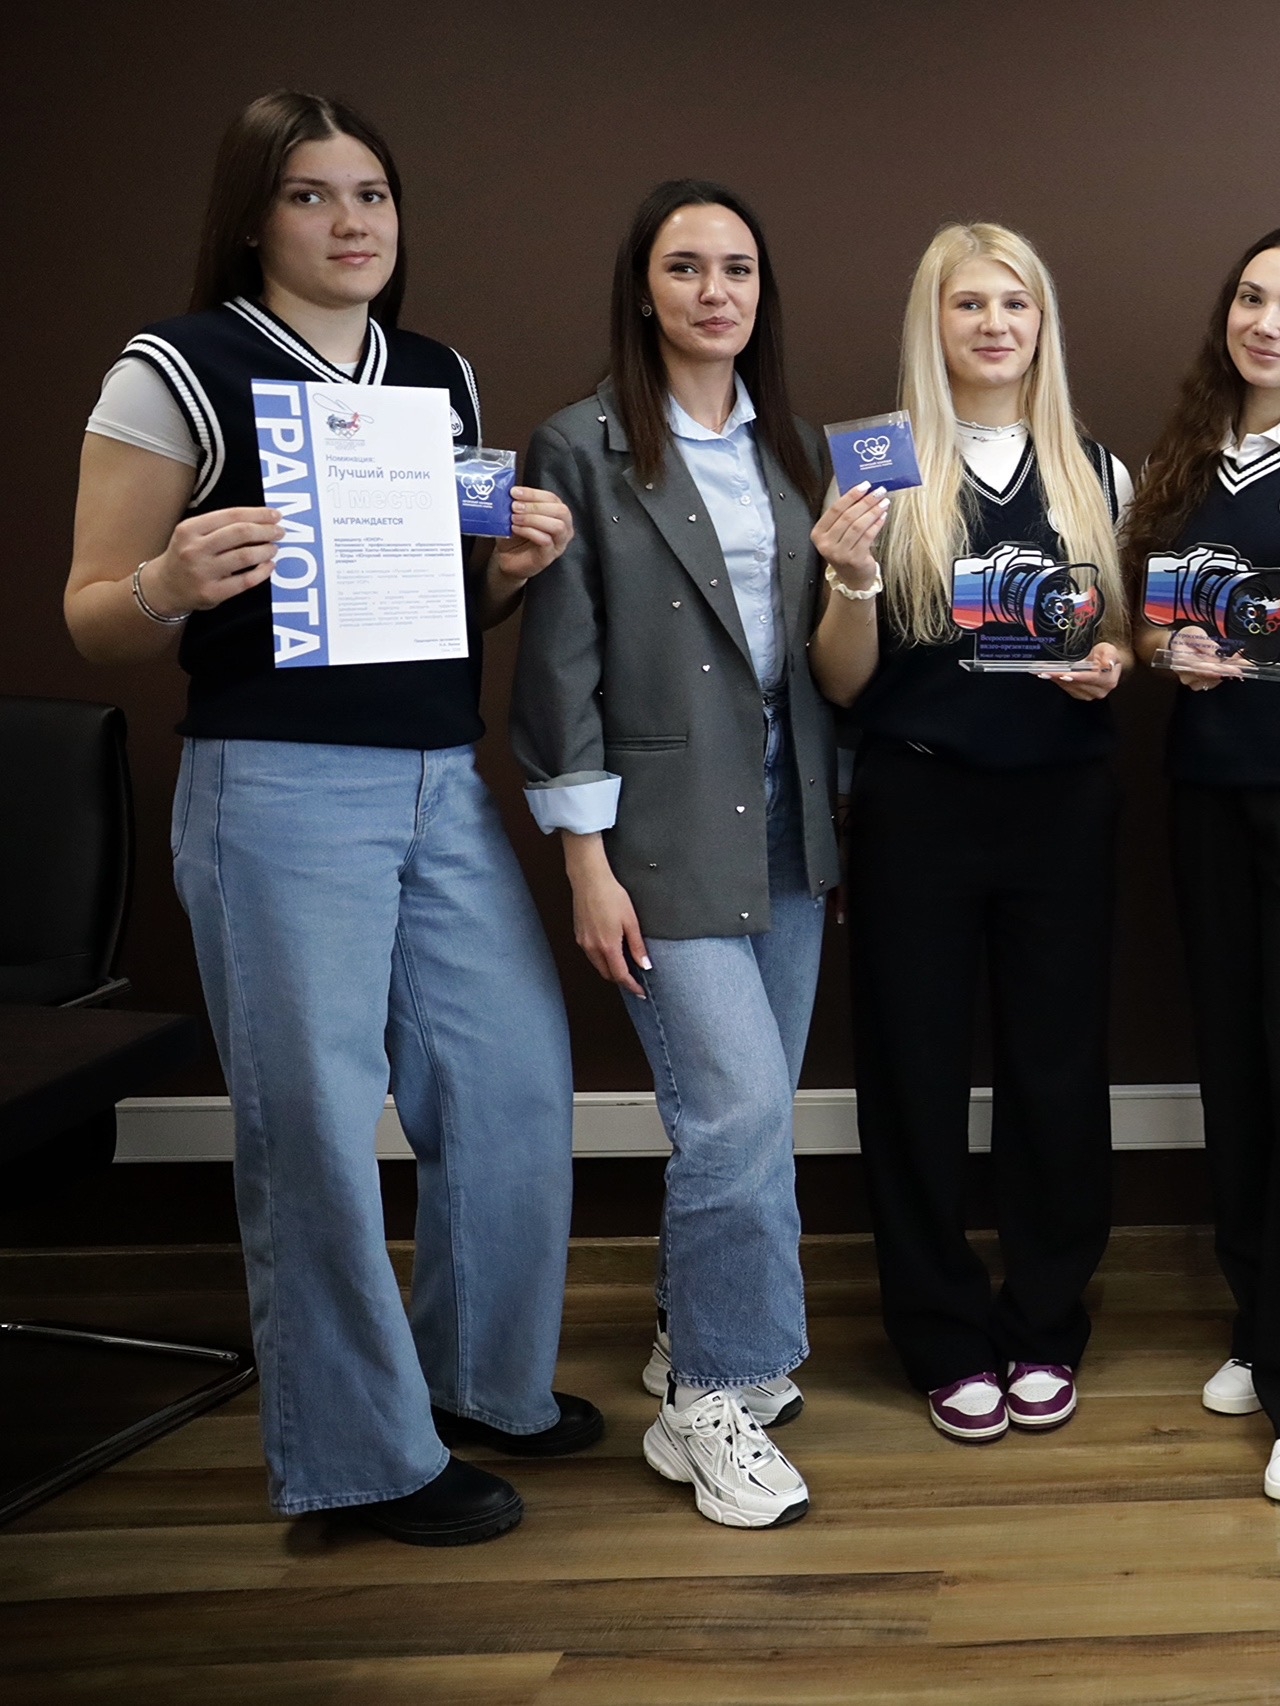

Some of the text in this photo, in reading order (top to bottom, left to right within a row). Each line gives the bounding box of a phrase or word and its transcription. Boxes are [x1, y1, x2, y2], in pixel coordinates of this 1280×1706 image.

[328, 465, 430, 482] Лучший ролик
[326, 482, 432, 510] 1 место
[252, 383, 321, 664] ГРАМОТА
[333, 517, 403, 526] НАГРАЖДАЕТСЯ
